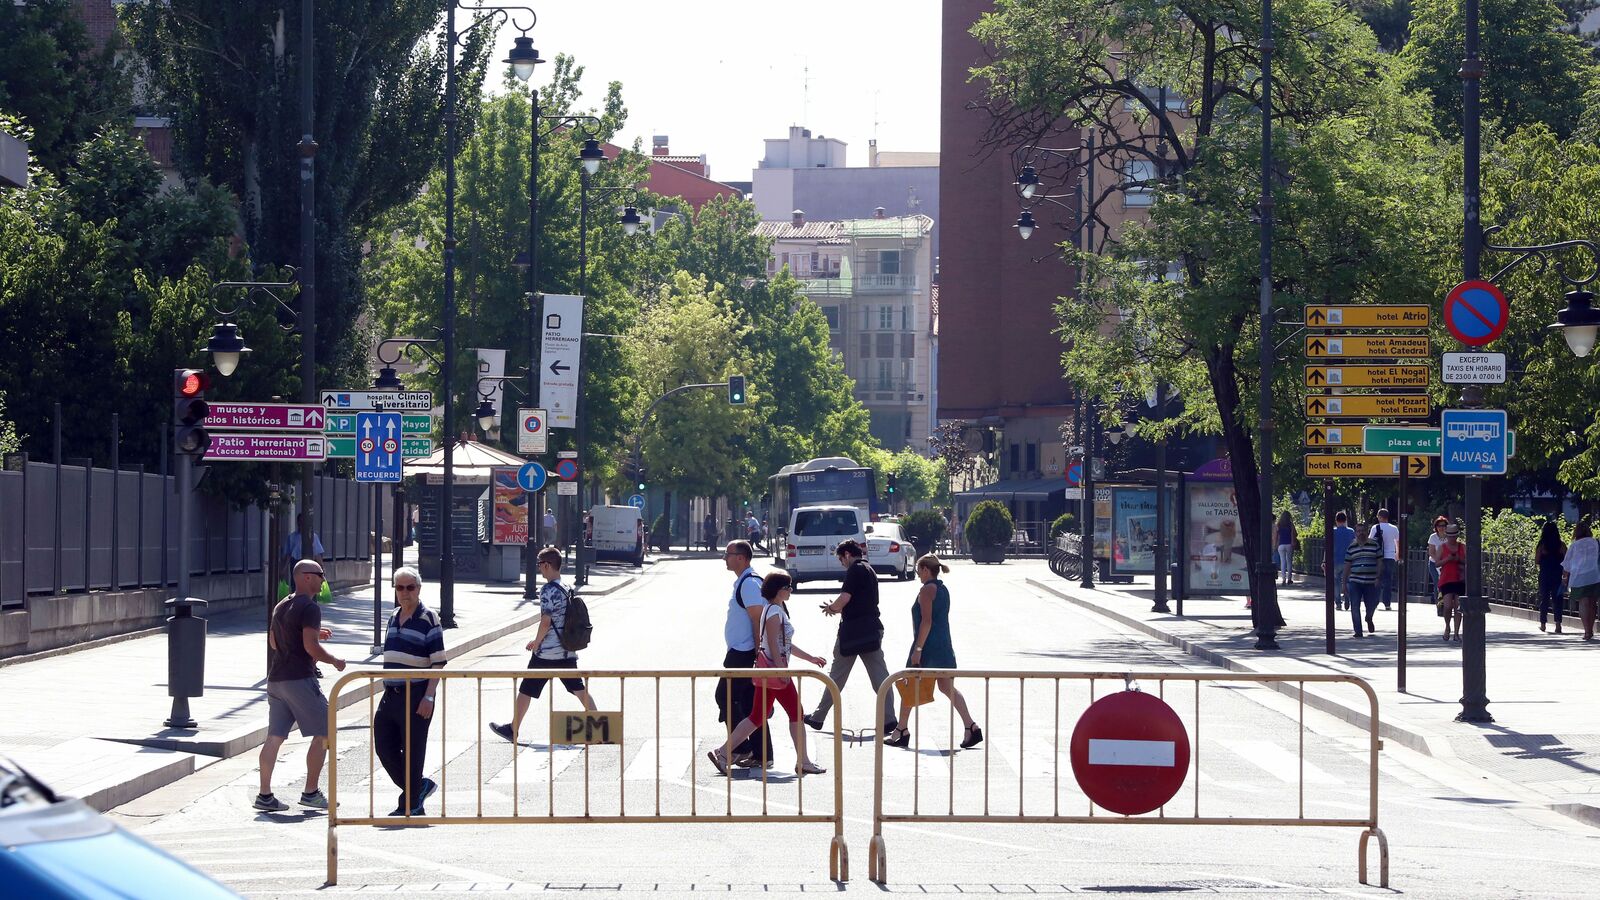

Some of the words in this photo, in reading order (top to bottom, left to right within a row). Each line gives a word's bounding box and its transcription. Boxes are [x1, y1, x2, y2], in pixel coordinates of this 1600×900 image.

[1402, 312, 1426, 320] Atrio
[1402, 368, 1426, 376] Nogal
[233, 416, 281, 424] históricos
[402, 421, 429, 429] Mayor
[218, 438, 245, 446] Patio
[251, 438, 305, 447] Herreriano
[1388, 439, 1411, 447] plaza
[255, 448, 296, 456] peatonal)
[1452, 451, 1496, 462] AUVASA
[566, 716, 609, 741] PM
